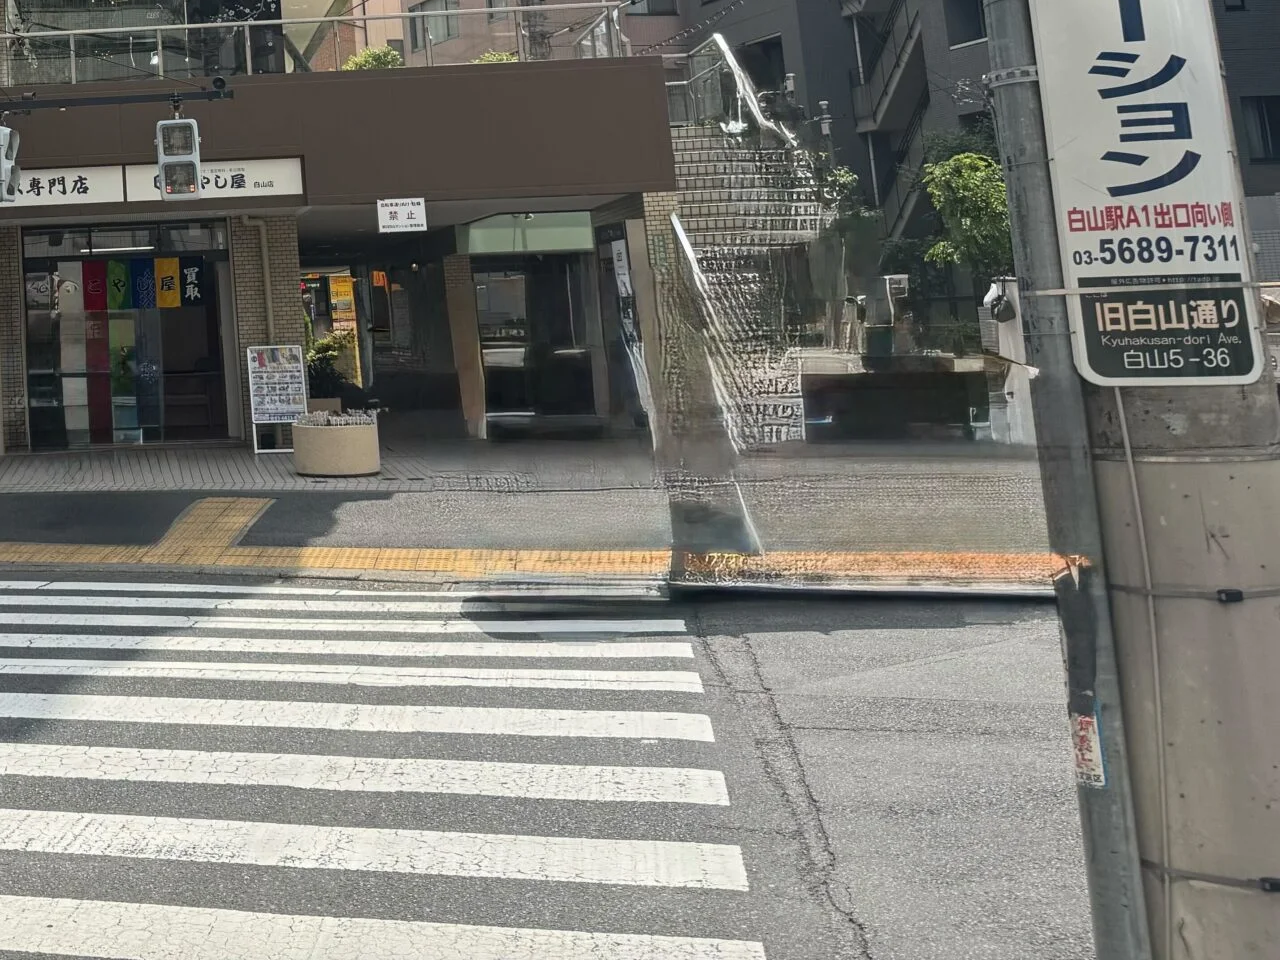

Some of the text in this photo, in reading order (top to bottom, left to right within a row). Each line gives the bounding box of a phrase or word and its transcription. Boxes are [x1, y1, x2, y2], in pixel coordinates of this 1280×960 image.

[1067, 201, 1234, 233] 白山駅A1出口向い側
[1073, 235, 1240, 266] 03-5689-7311
[184, 267, 201, 301] 買取
[1095, 299, 1240, 332] 旧白山通り
[1101, 332, 1242, 348] Kyuhakusan-dori Ave.
